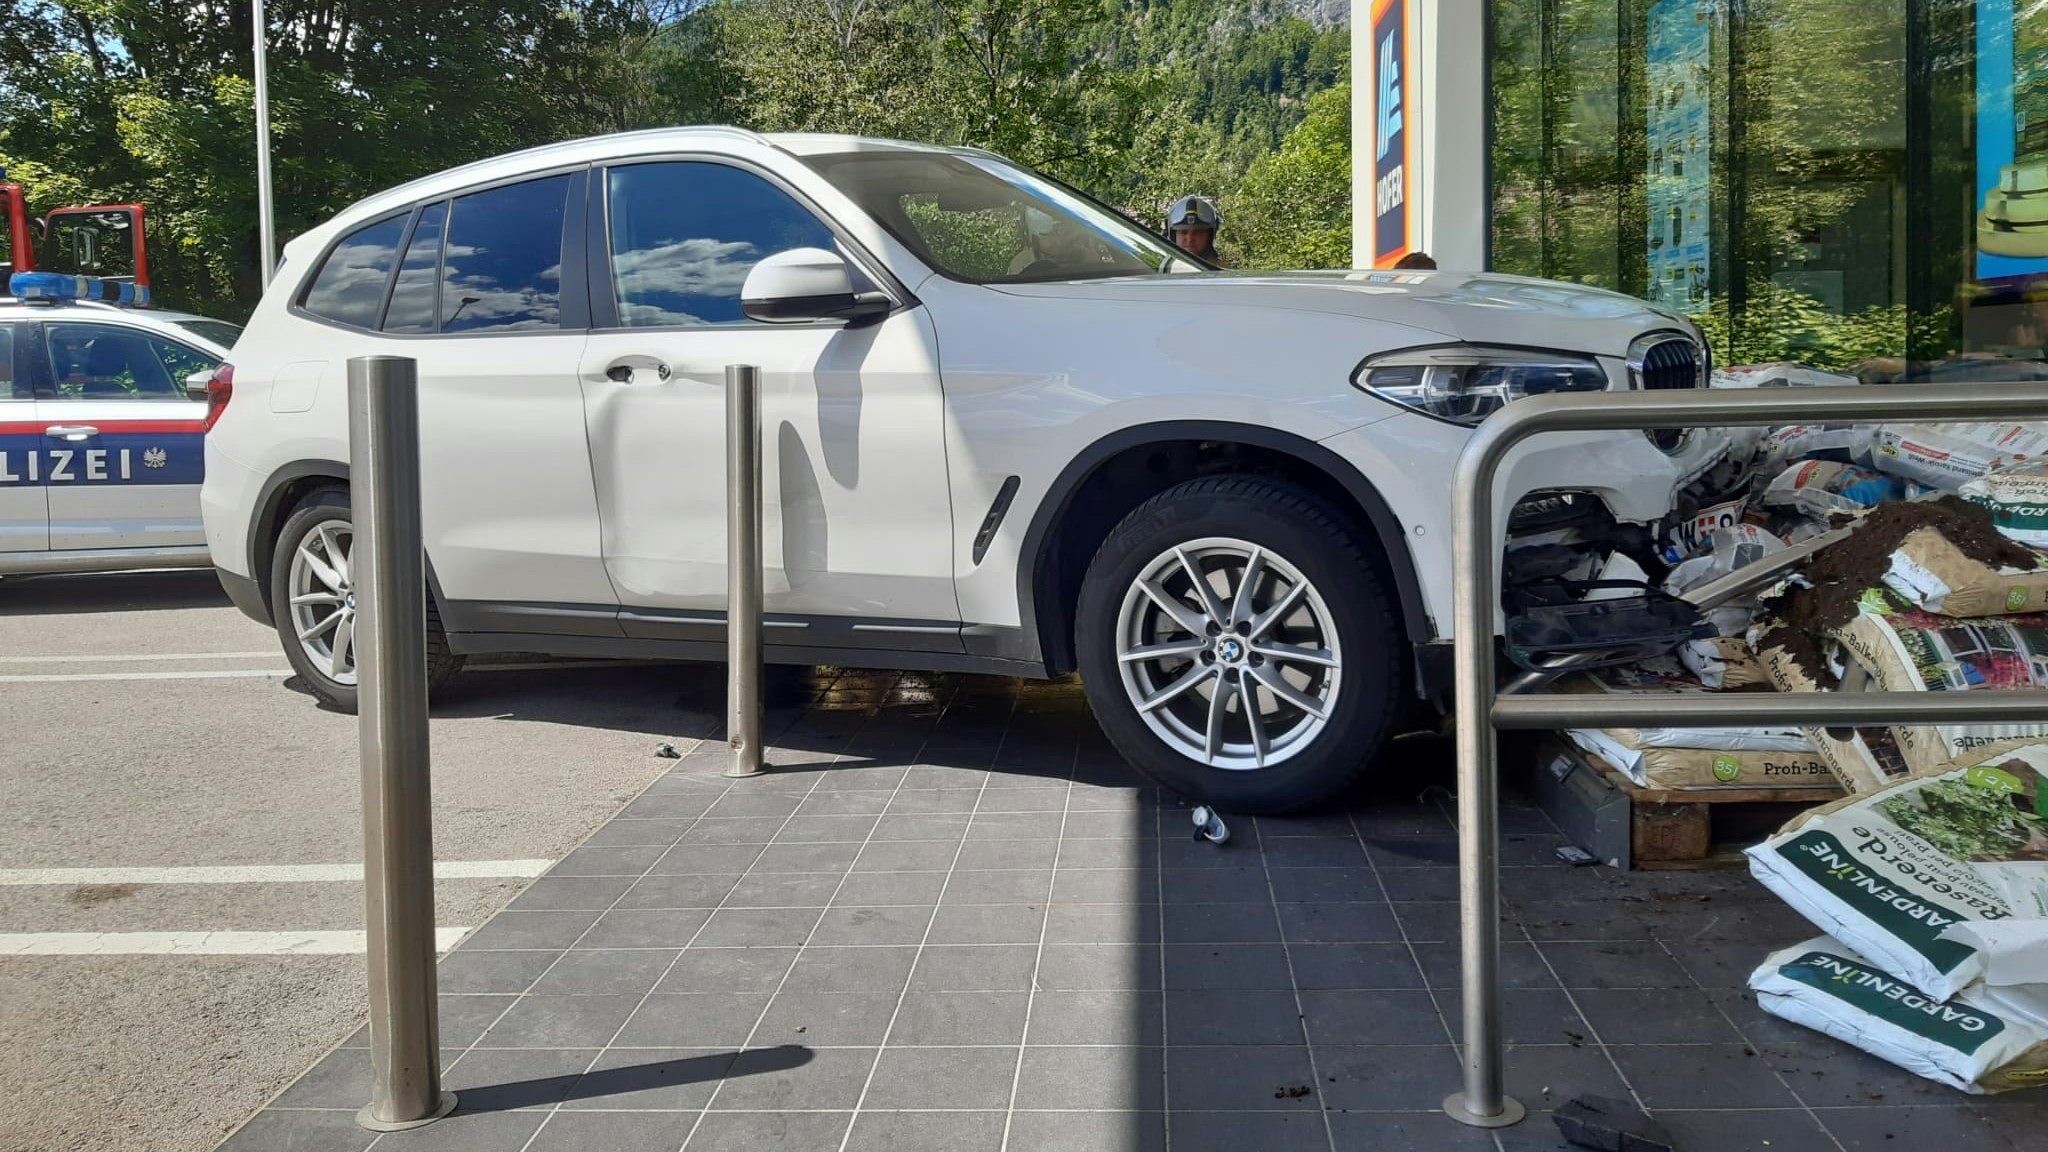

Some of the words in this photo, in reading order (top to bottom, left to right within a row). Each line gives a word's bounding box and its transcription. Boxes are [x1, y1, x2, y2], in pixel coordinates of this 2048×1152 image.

[1377, 165, 1403, 217] HOFER
[1808, 841, 1954, 930] ARDENLINE
[1852, 826, 2013, 920] Rasenerde
[1810, 956, 1986, 1032] GARDENLINE
